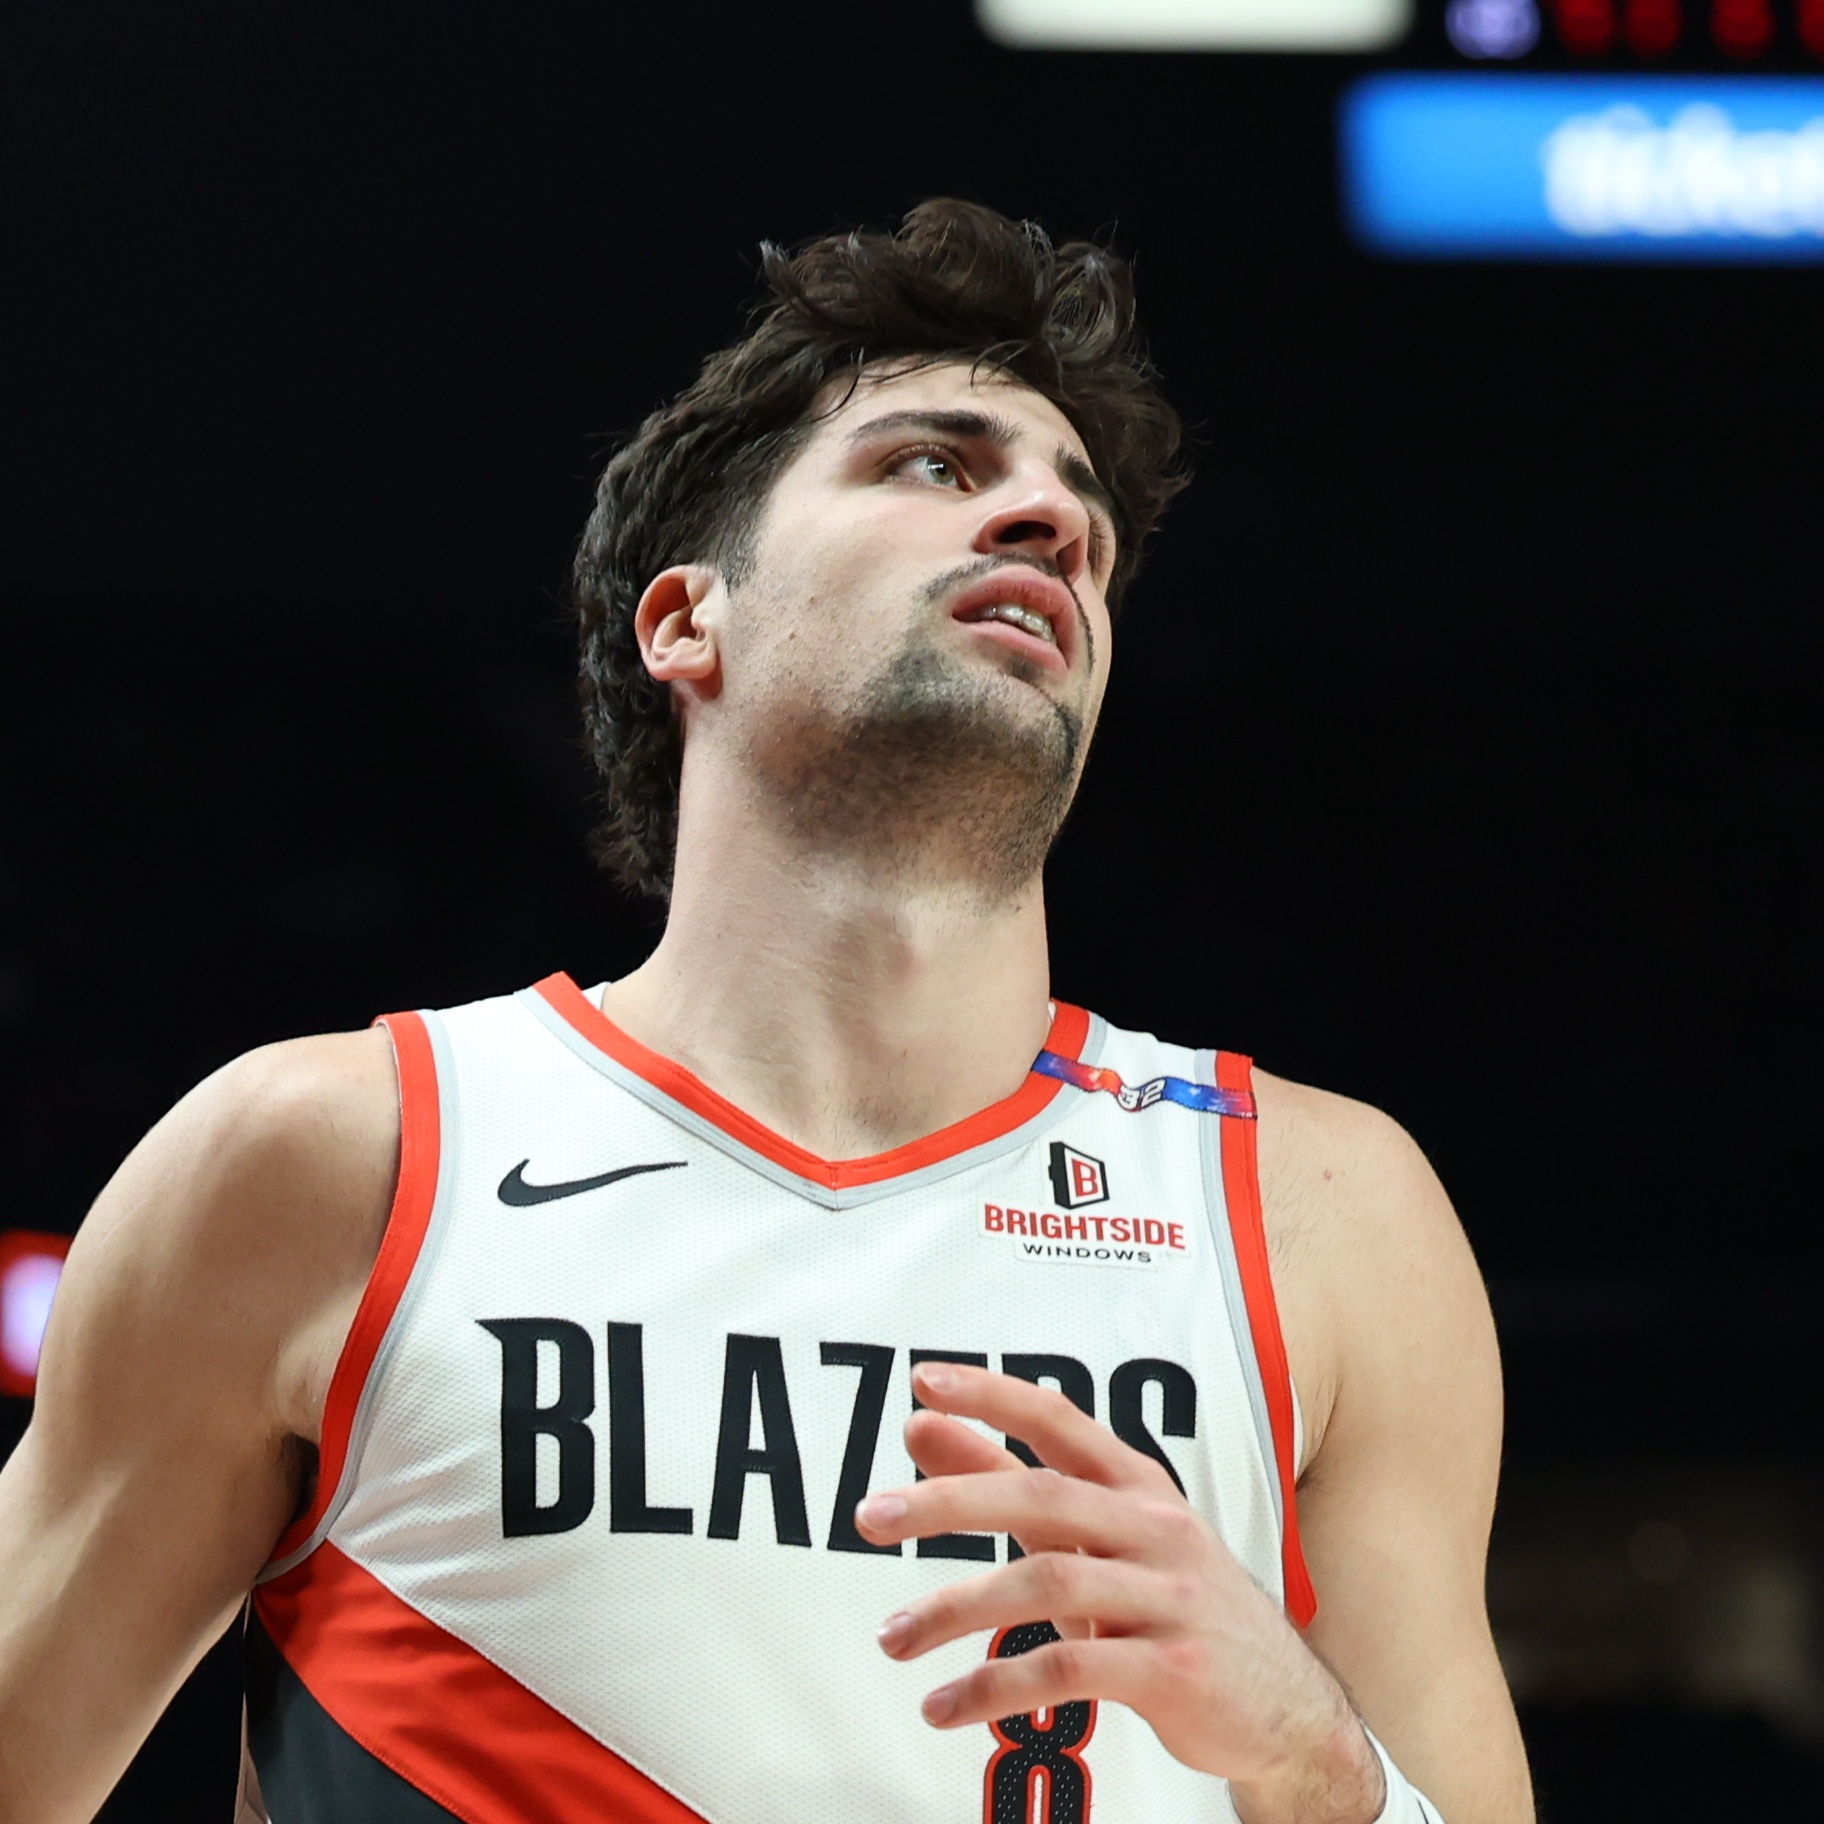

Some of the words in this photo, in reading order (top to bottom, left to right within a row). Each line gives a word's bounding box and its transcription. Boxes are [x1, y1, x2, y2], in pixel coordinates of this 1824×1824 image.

[1071, 1157, 1098, 1198] B
[984, 1203, 1186, 1250] BRIGHTSIDE
[1023, 1243, 1152, 1263] WINDOWS
